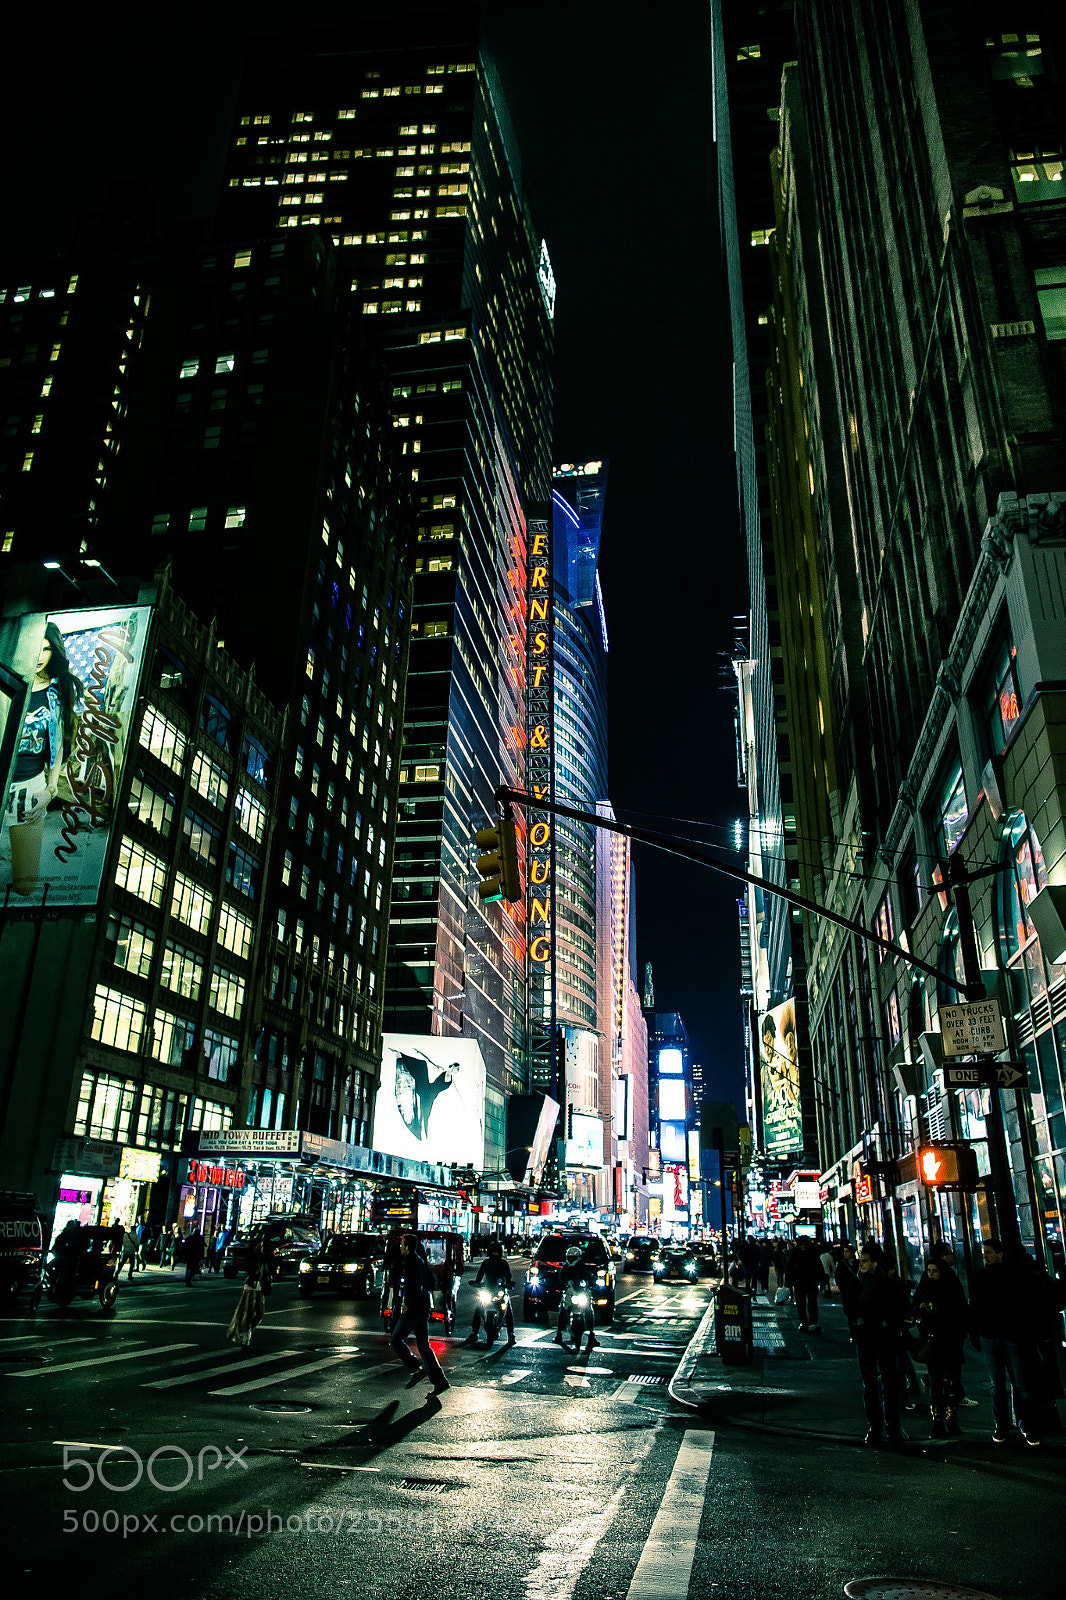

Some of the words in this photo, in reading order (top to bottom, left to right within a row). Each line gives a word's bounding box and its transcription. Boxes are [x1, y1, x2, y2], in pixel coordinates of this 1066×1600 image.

[530, 535, 548, 688] ERNST
[530, 724, 548, 748] &
[530, 786, 548, 962] YOUNG
[945, 1010, 957, 1019] NO
[961, 1005, 994, 1017] TRUCKS
[946, 1020, 964, 1029] OVER
[968, 1017, 977, 1026] 33
[980, 1014, 996, 1024] FEET
[955, 1030, 964, 1038] AT
[971, 1026, 991, 1036] CURB
[955, 1070, 979, 1081] ONE
[995, 1069, 1016, 1081] AY
[224, 1131, 250, 1141] TOWN
[253, 1131, 288, 1141] BUFFET
